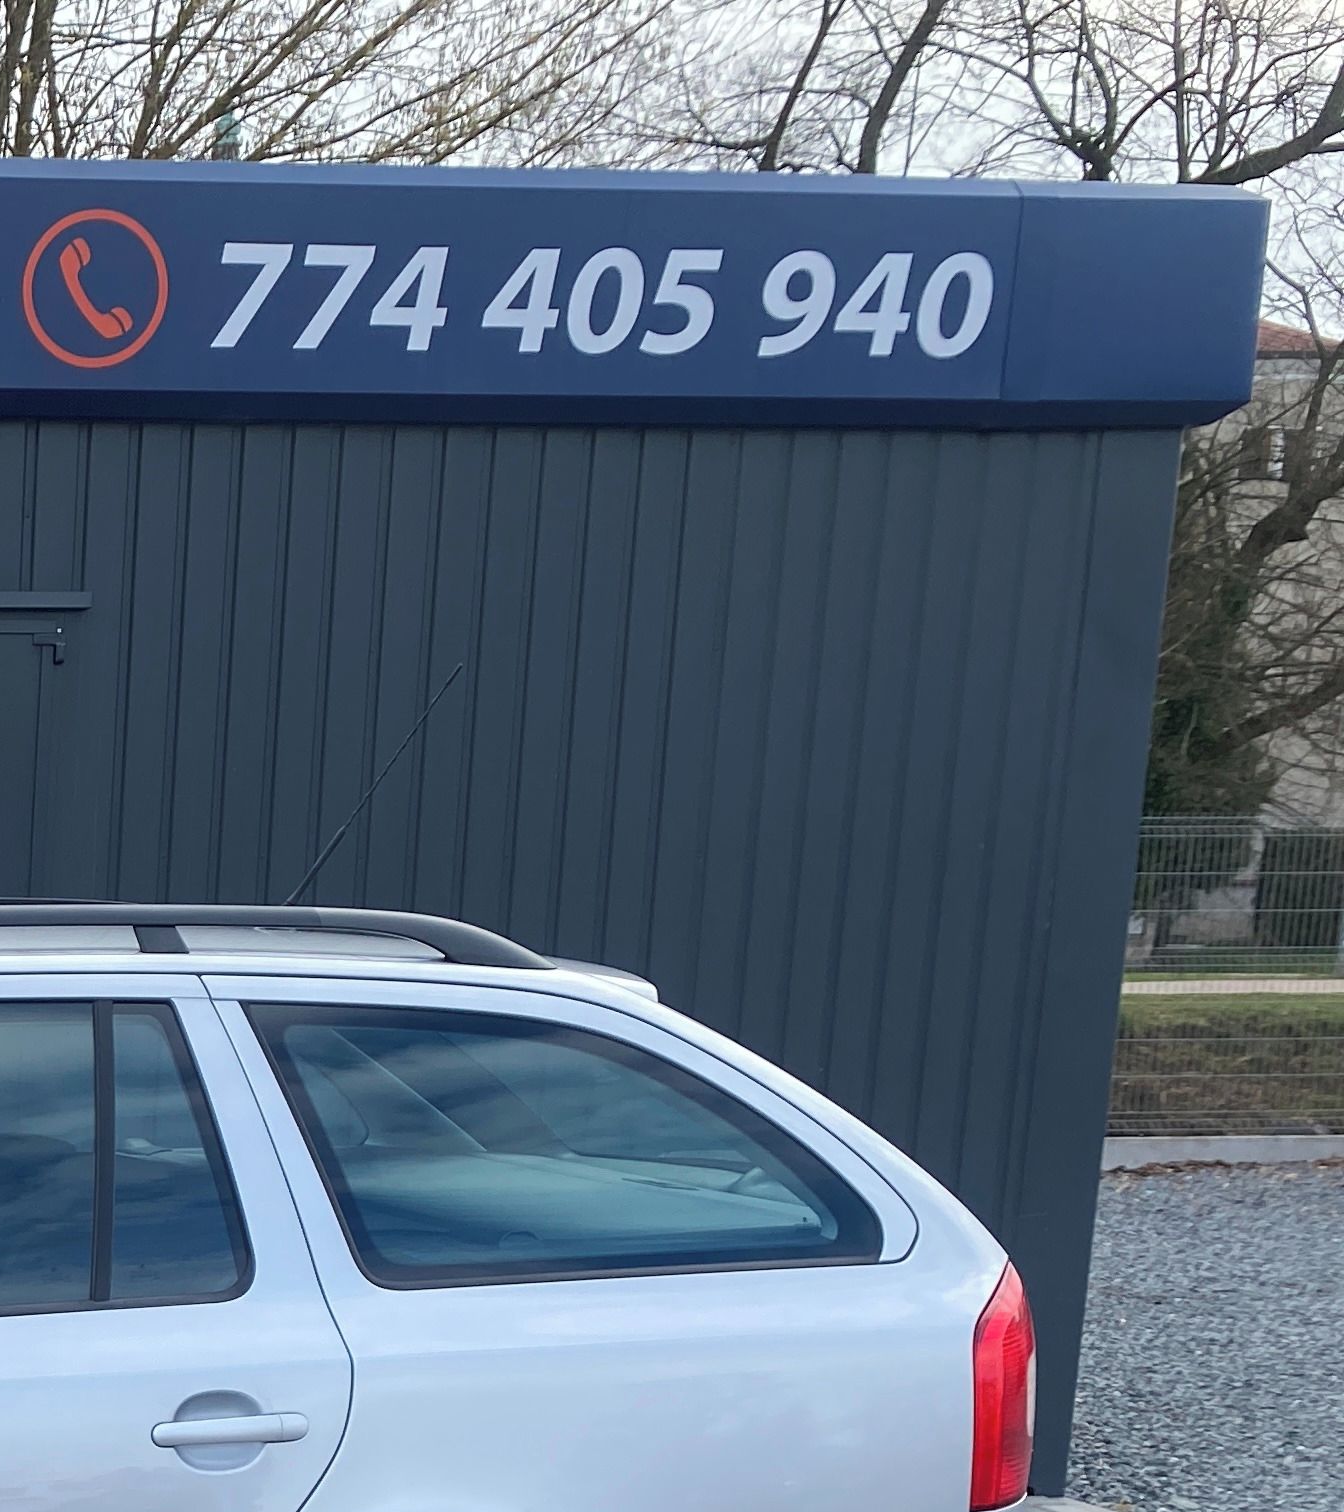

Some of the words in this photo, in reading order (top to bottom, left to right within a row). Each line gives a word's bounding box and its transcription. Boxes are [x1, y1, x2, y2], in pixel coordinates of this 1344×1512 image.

[209, 242, 450, 351] 774
[480, 247, 724, 355] 405
[757, 250, 994, 358] 940
